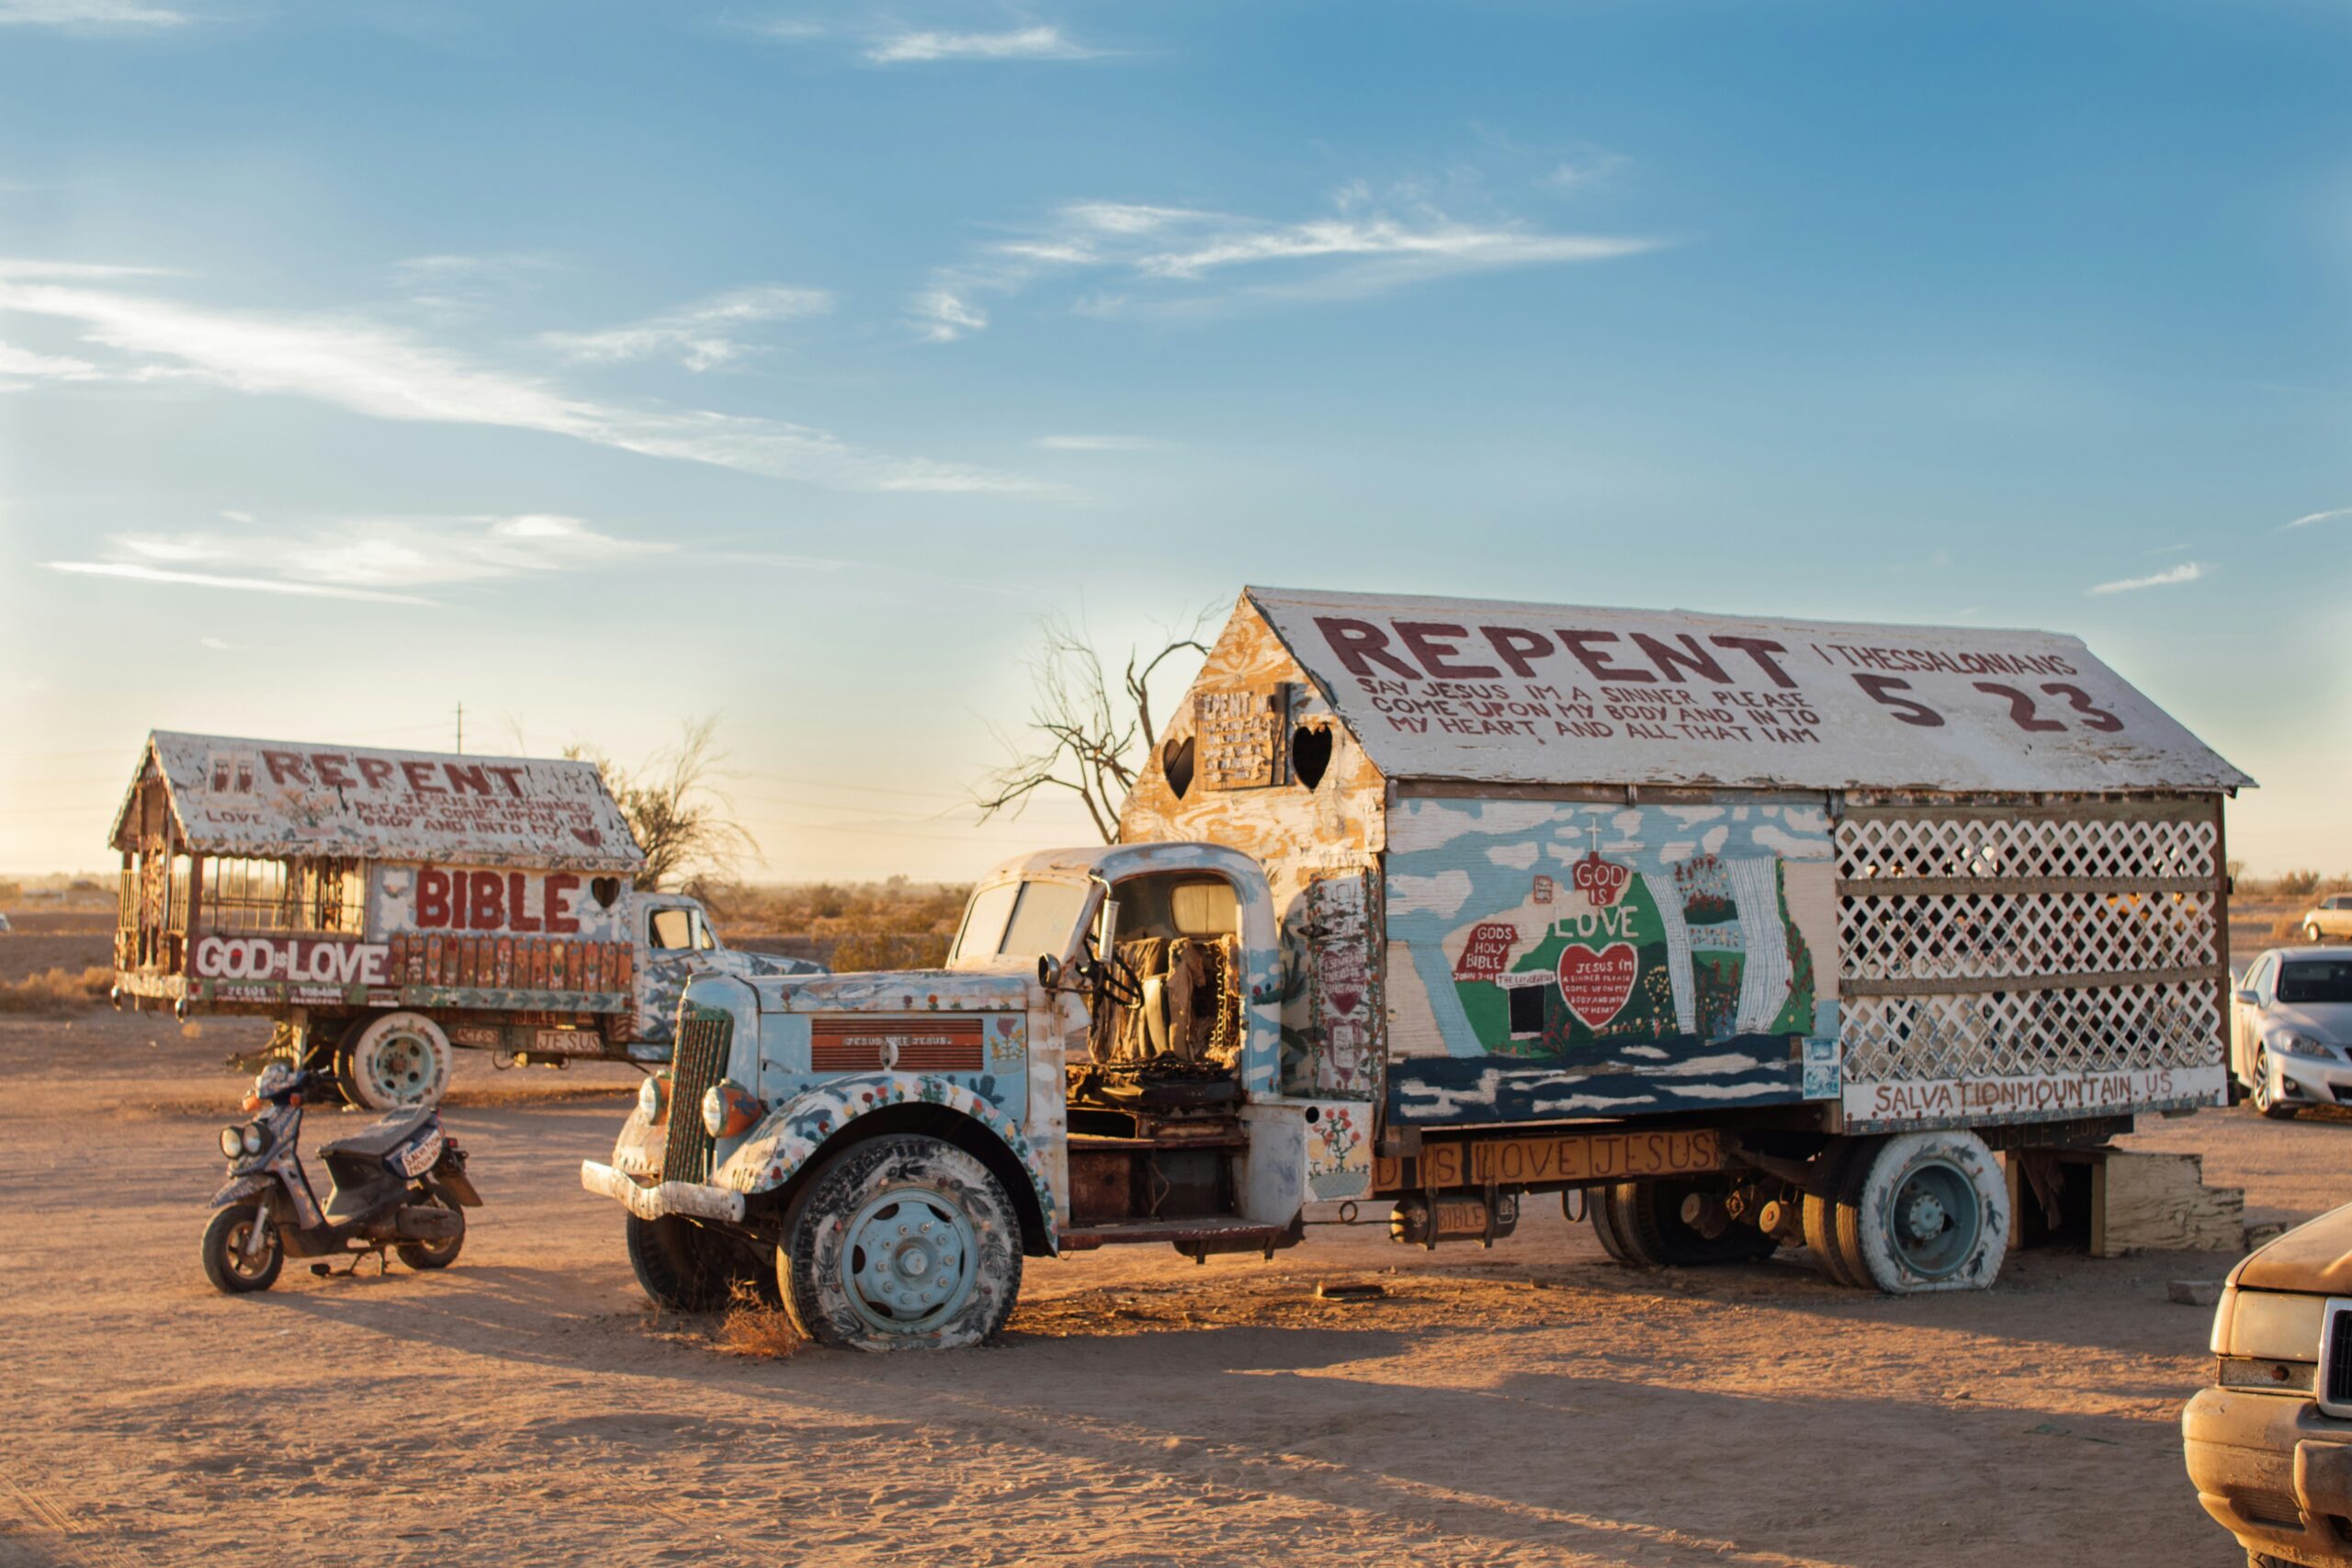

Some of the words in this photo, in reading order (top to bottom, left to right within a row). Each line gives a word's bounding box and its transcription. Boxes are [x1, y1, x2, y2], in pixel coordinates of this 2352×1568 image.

[1312, 617, 1798, 688] REPENT
[1826, 644, 2078, 676] THESSALONIANS
[1355, 677, 1410, 696] SAY
[1421, 682, 1510, 700] JESUS
[1572, 686, 1592, 701] A
[1600, 687, 1699, 705] SINNER
[1712, 691, 1814, 708] PLEASE
[1849, 673, 1945, 728] 5
[1371, 696, 1459, 716] COME
[1466, 700, 1552, 718] UPON
[1555, 703, 1594, 719] MY
[1603, 705, 1668, 721] BODY
[1679, 708, 1735, 724] AND
[1385, 716, 1428, 733] MY
[1555, 720, 1613, 738] AND
[1625, 723, 1678, 739] ALL
[1673, 724, 1753, 741] THAT
[261, 750, 526, 798] REPENT
[355, 800, 430, 817] PLEASE
[440, 807, 488, 821] COME
[502, 810, 556, 823] UPON
[569, 813, 594, 826] MY
[401, 793, 469, 808] JESUS
[526, 799, 589, 813] SINNER
[205, 809, 266, 825] LOVE
[363, 816, 412, 829] BODY
[423, 819, 466, 833] AND
[474, 821, 523, 835] INTO
[531, 823, 561, 840] MY
[1576, 863, 1624, 887] GOD
[416, 869, 581, 934] BIBLE
[1590, 888, 1607, 905] IS
[1476, 926, 1512, 941] GODS
[1553, 905, 1639, 938] LOVE
[196, 936, 276, 980] GOD
[287, 940, 390, 985] LOVE
[1475, 942, 1506, 955] HOLY
[1465, 953, 1502, 970] BIBLE
[1576, 961, 1613, 974] JESUS
[1453, 972, 1476, 981] JOHN
[1570, 975, 1600, 983] SINNER
[1602, 975, 1631, 983] PLEASE
[1565, 985, 1588, 993] COME
[1614, 985, 1628, 993] MY
[1570, 996, 1591, 1004] BODY
[538, 1032, 601, 1051] JESUS
[844, 1036, 882, 1045] JESUS
[1476, 1138, 1577, 1181] LOVE
[1594, 1132, 1713, 1176] JESUS
[1437, 1205, 1485, 1230] BIBLE
